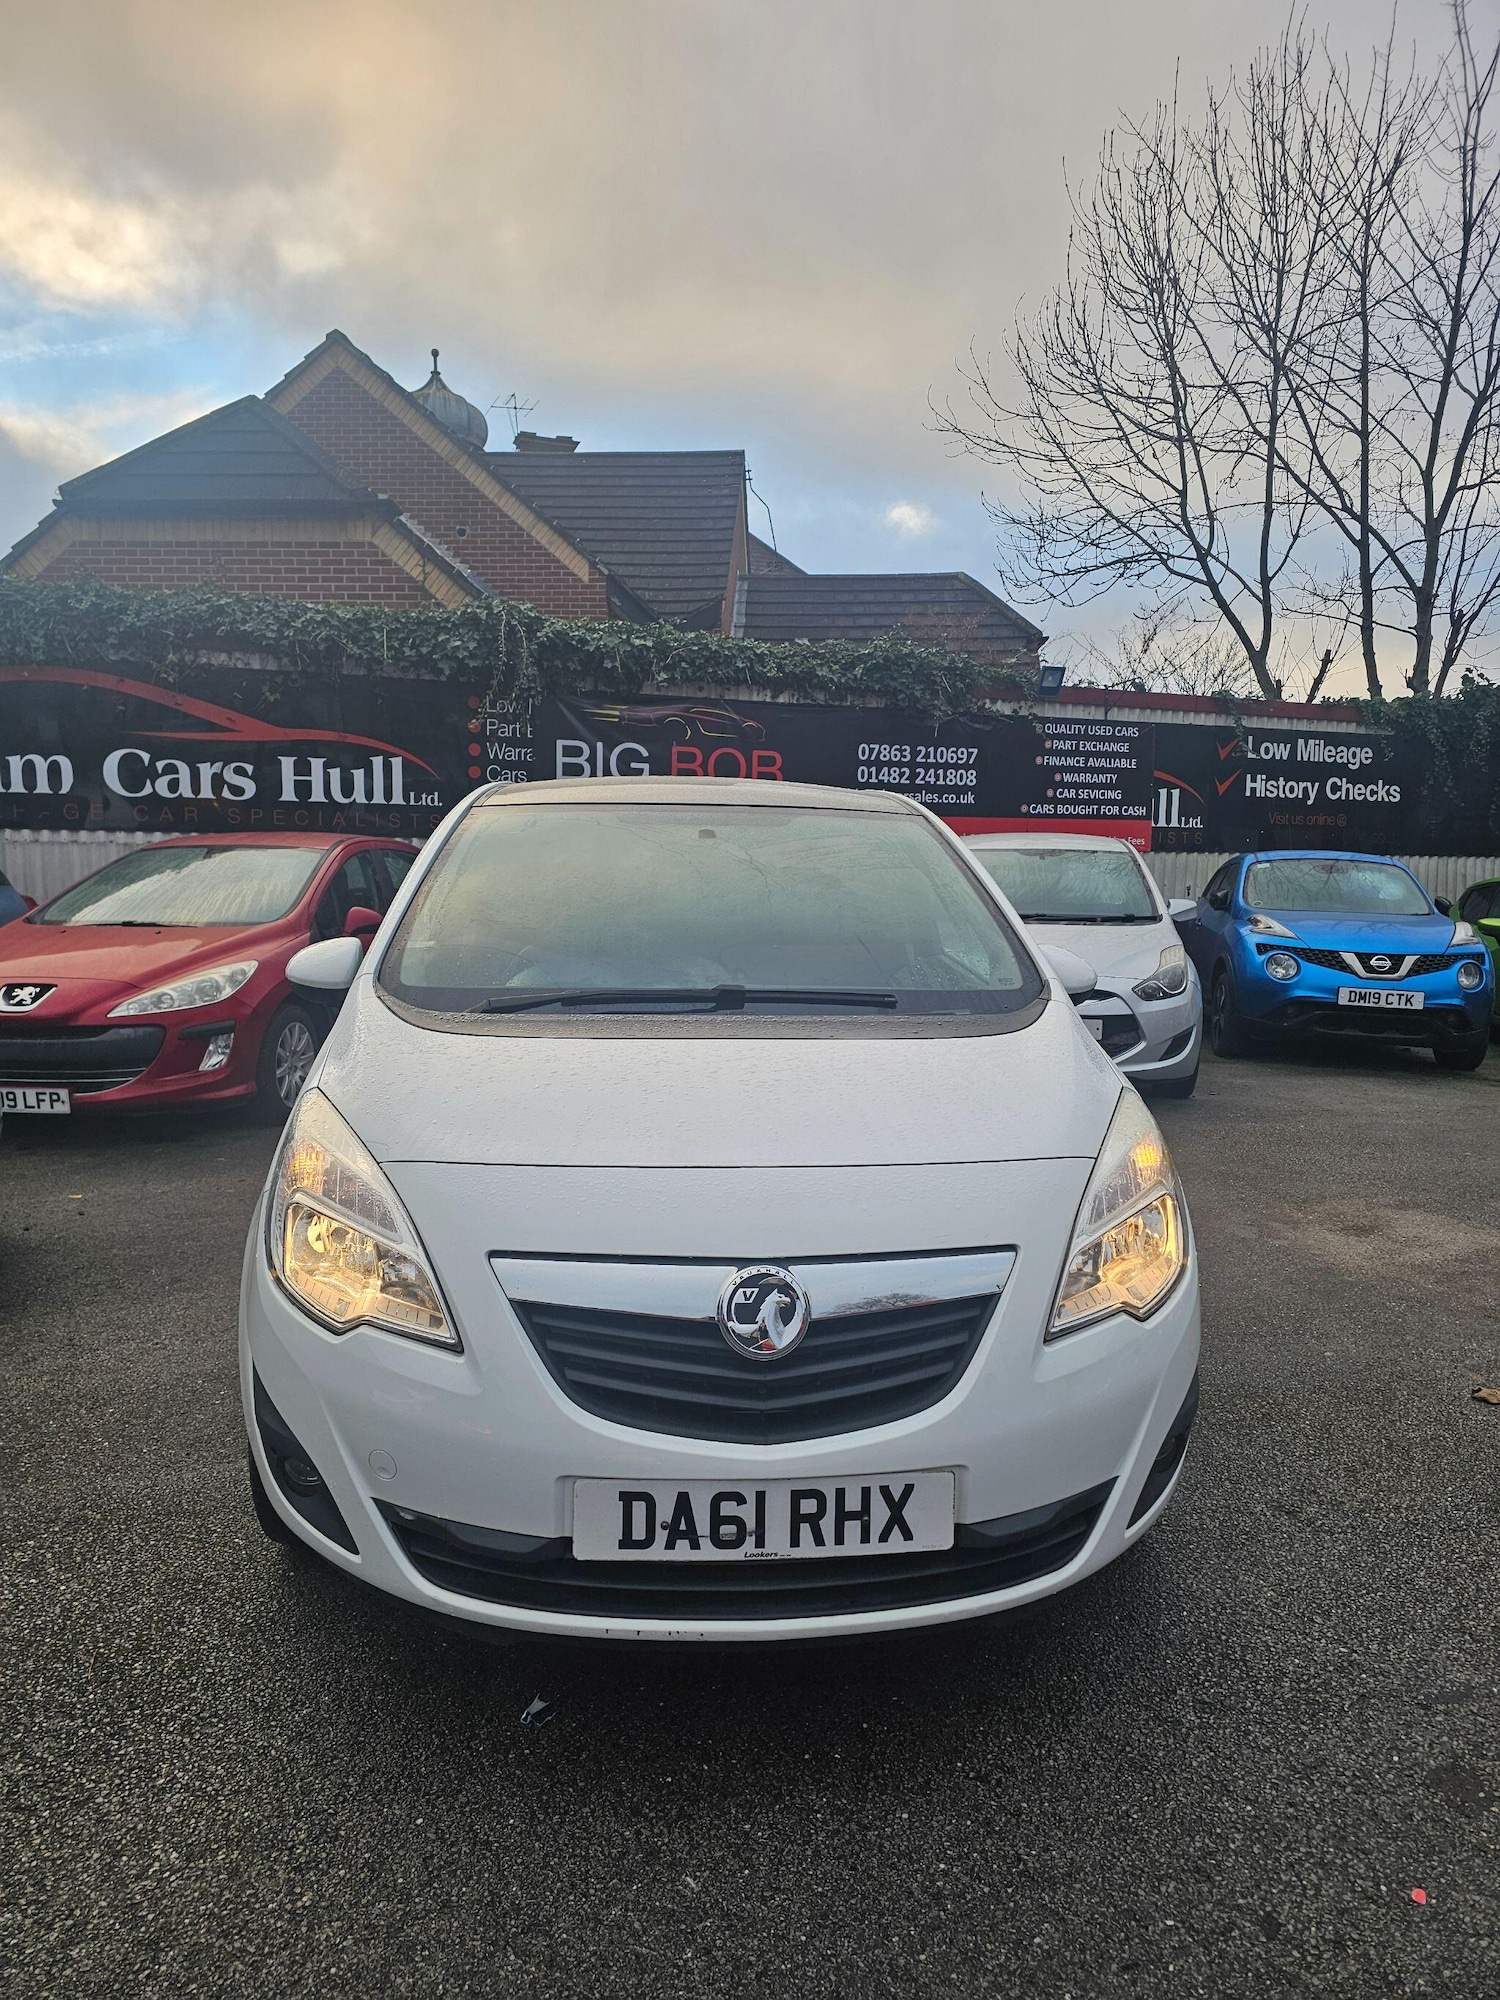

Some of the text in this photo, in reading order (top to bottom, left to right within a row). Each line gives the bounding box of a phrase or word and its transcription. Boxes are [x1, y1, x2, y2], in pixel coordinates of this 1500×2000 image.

[486, 718, 521, 737] Part
[1045, 723, 1140, 738] QUALITY USED CARS
[858, 744, 978, 764] 07863 210697
[1053, 740, 1130, 753] PART EXCHANGE
[1247, 736, 1373, 769] Low Mileage
[556, 739, 650, 780] BIG
[1044, 756, 1137, 768] FINANCE AVALIABLE
[0, 749, 442, 806] m Cars Hull Ltd.
[486, 765, 527, 782] Cars
[858, 766, 976, 786] 01482 241808
[1063, 773, 1117, 783] WARRANTY
[1057, 789, 1121, 799] CAR SEVICING
[1246, 774, 1400, 805] History Checks
[135, 804, 441, 830] CAR SPECIALISTS
[1030, 804, 1146, 815] CARS BOUGHT FOR CASH
[1152, 788, 1203, 828] ll Ltd.
[1268, 811, 1289, 825] Visit
[1291, 815, 1304, 825] us
[1127, 836, 1146, 846] Fees
[1347, 990, 1415, 1007] DM19 CTK
[22, 1091, 61, 1109] LFP
[732, 1268, 795, 1286] VAUXHALL
[618, 1483, 915, 1551] DA61 RHX
[744, 1551, 779, 1559] Lookers
